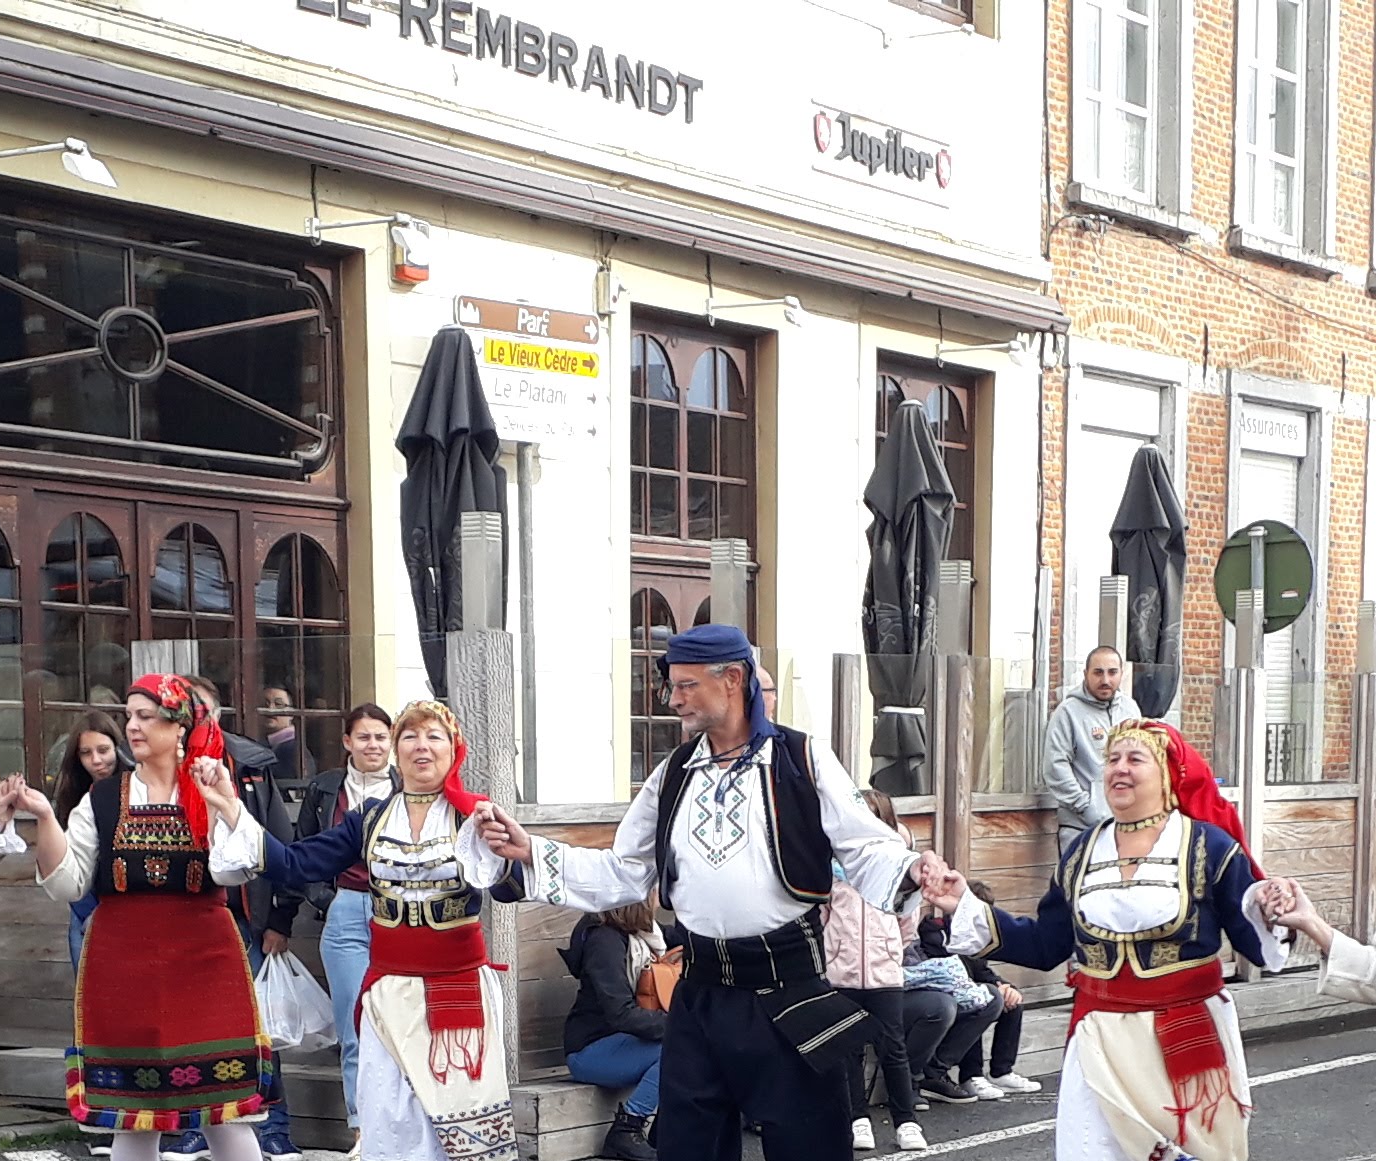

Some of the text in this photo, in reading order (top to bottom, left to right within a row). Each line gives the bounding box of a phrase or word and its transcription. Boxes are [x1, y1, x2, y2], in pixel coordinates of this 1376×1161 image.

[398, 0, 704, 124] REMBRANDT
[834, 112, 934, 182] Jupiler
[490, 339, 578, 373] Le Vieux Cèdre
[494, 377, 512, 399] Le
[1239, 411, 1298, 440] Assurances
